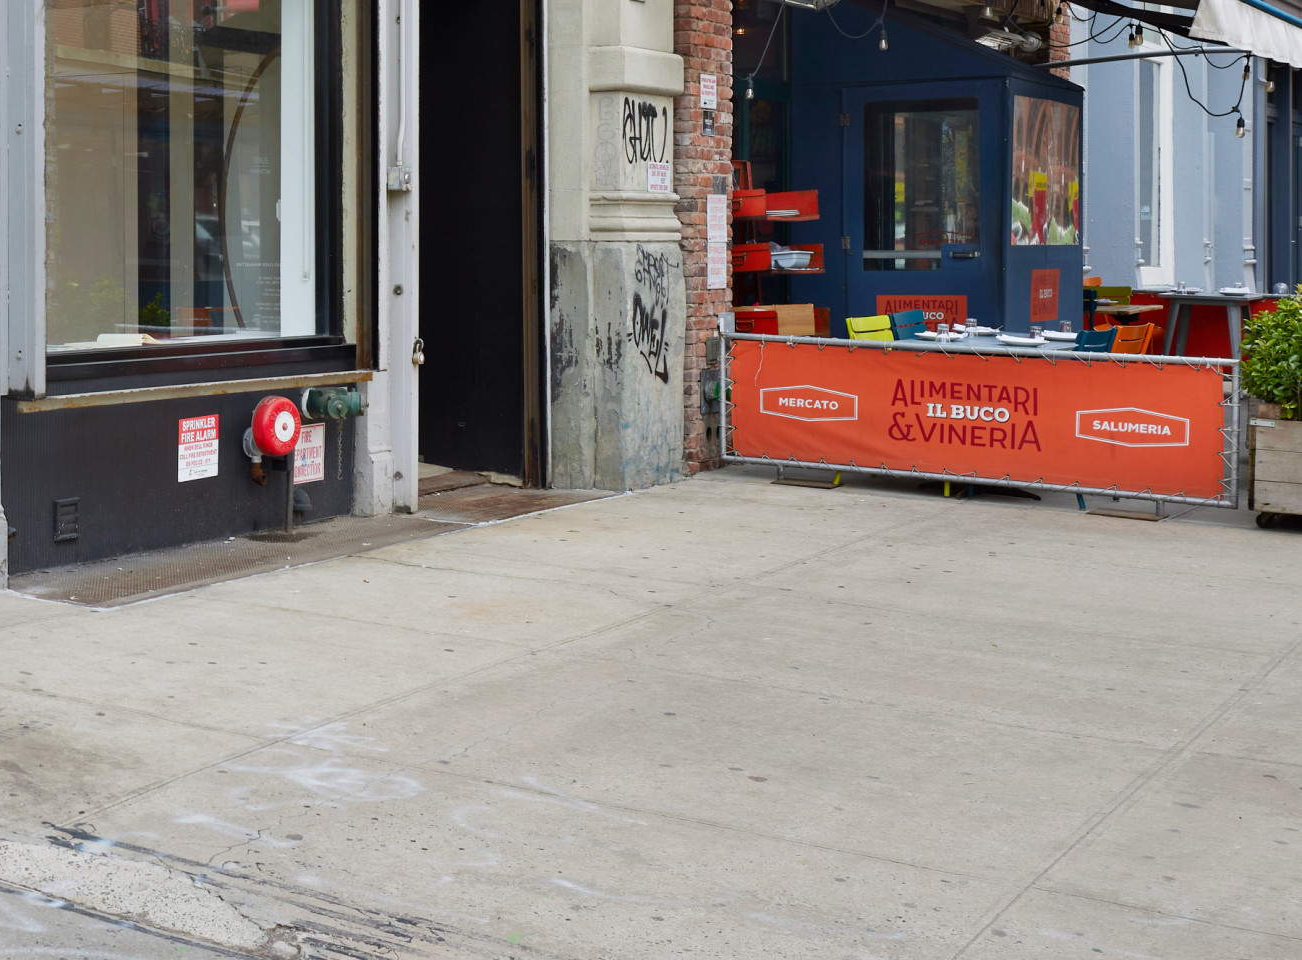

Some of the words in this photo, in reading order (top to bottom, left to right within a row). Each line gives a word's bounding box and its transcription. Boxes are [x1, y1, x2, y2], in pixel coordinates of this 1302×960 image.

[885, 300, 958, 315] ALIMENTARI
[922, 312, 944, 320] UCO
[778, 397, 839, 410] MERCATO
[891, 378, 1038, 416] ALIMENTARI
[926, 403, 946, 418] IL
[950, 405, 1010, 422] BUCO
[182, 417, 216, 431] SPRINKLER
[1092, 419, 1171, 436] SALUMERIA
[181, 432, 195, 444] FIRE
[196, 429, 217, 442] ALARM
[301, 430, 312, 443] FIRE
[197, 449, 218, 458] DEPARTMENT
[294, 445, 322, 462] EPARTMENT
[294, 463, 322, 479] ONNECTION
